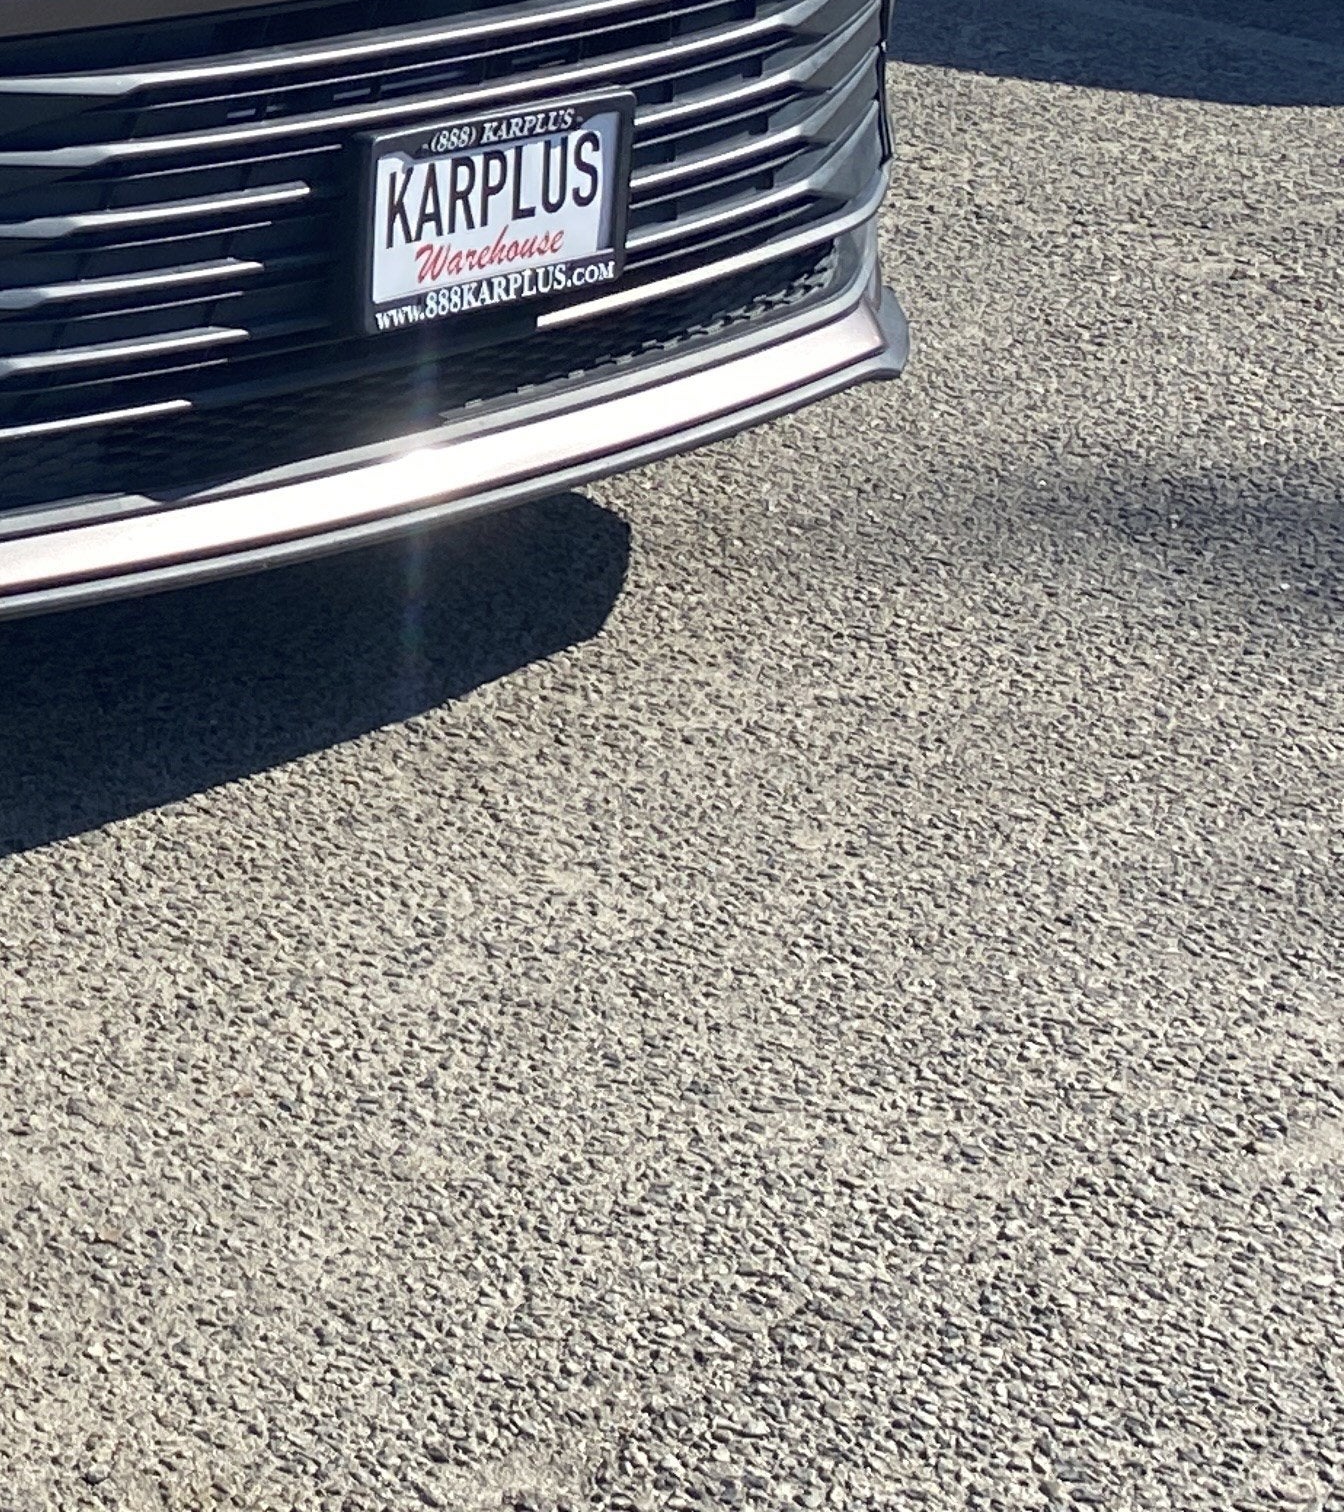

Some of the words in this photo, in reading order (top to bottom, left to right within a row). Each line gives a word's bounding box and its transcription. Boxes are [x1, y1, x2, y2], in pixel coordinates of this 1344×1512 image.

[431, 126, 477, 152] (888)
[480, 108, 575, 144] KARPLUS
[385, 130, 601, 249] KARPLUS
[414, 224, 565, 284] Warehouse
